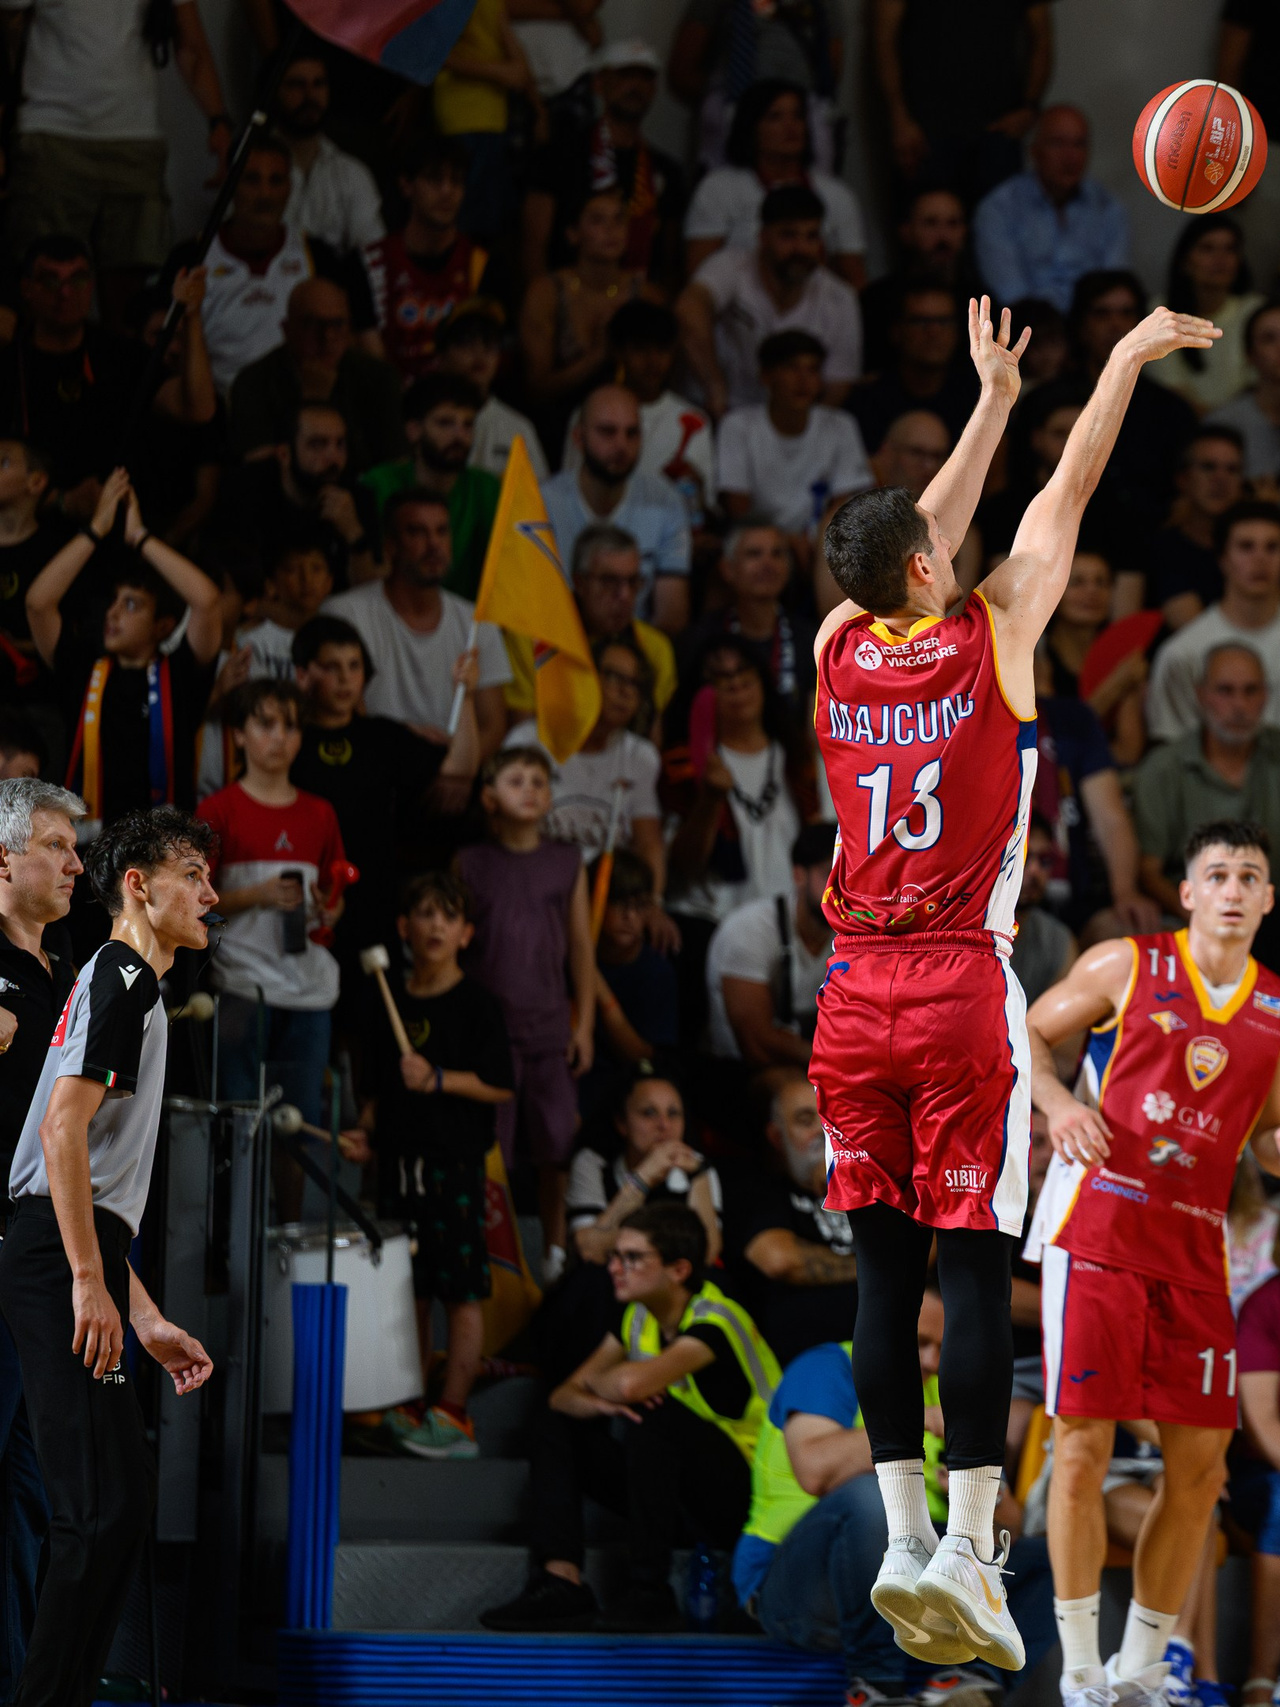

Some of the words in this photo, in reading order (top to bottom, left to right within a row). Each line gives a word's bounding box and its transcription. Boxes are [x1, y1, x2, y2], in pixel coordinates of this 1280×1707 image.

[1166, 111, 1192, 170] molten
[880, 643, 912, 656] IDEE
[913, 637, 941, 652] PER
[885, 644, 958, 668] VIAGGIARE
[856, 756, 943, 856] 13
[1148, 947, 1177, 983] 11
[1091, 1176, 1150, 1206] CONNECT
[102, 1373, 126, 1385] FIP
[1197, 1347, 1237, 1397] 11
